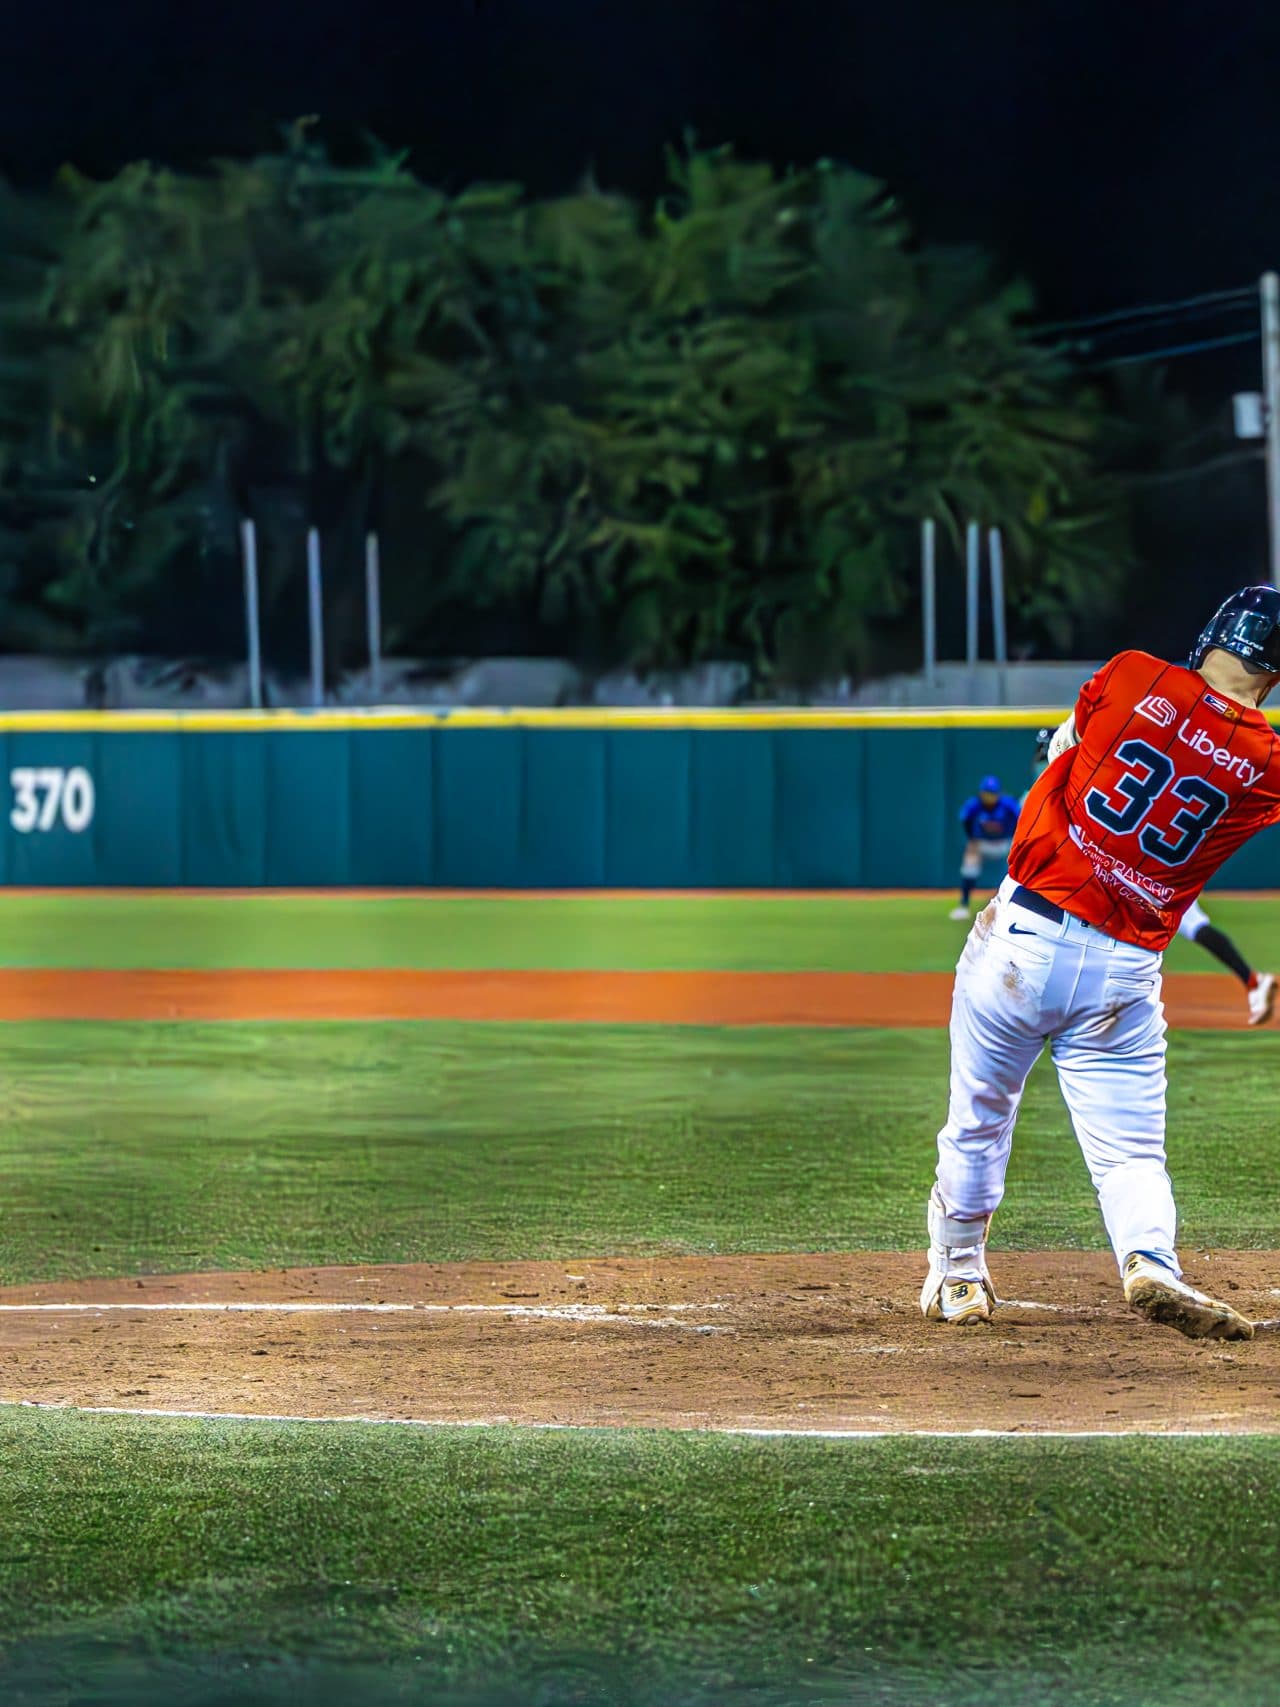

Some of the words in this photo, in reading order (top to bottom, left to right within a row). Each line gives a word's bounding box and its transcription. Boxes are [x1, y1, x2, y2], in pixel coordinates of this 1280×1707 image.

[1177, 718, 1264, 787] Liberty
[9, 766, 95, 833] 370
[1084, 738, 1229, 867] 33
